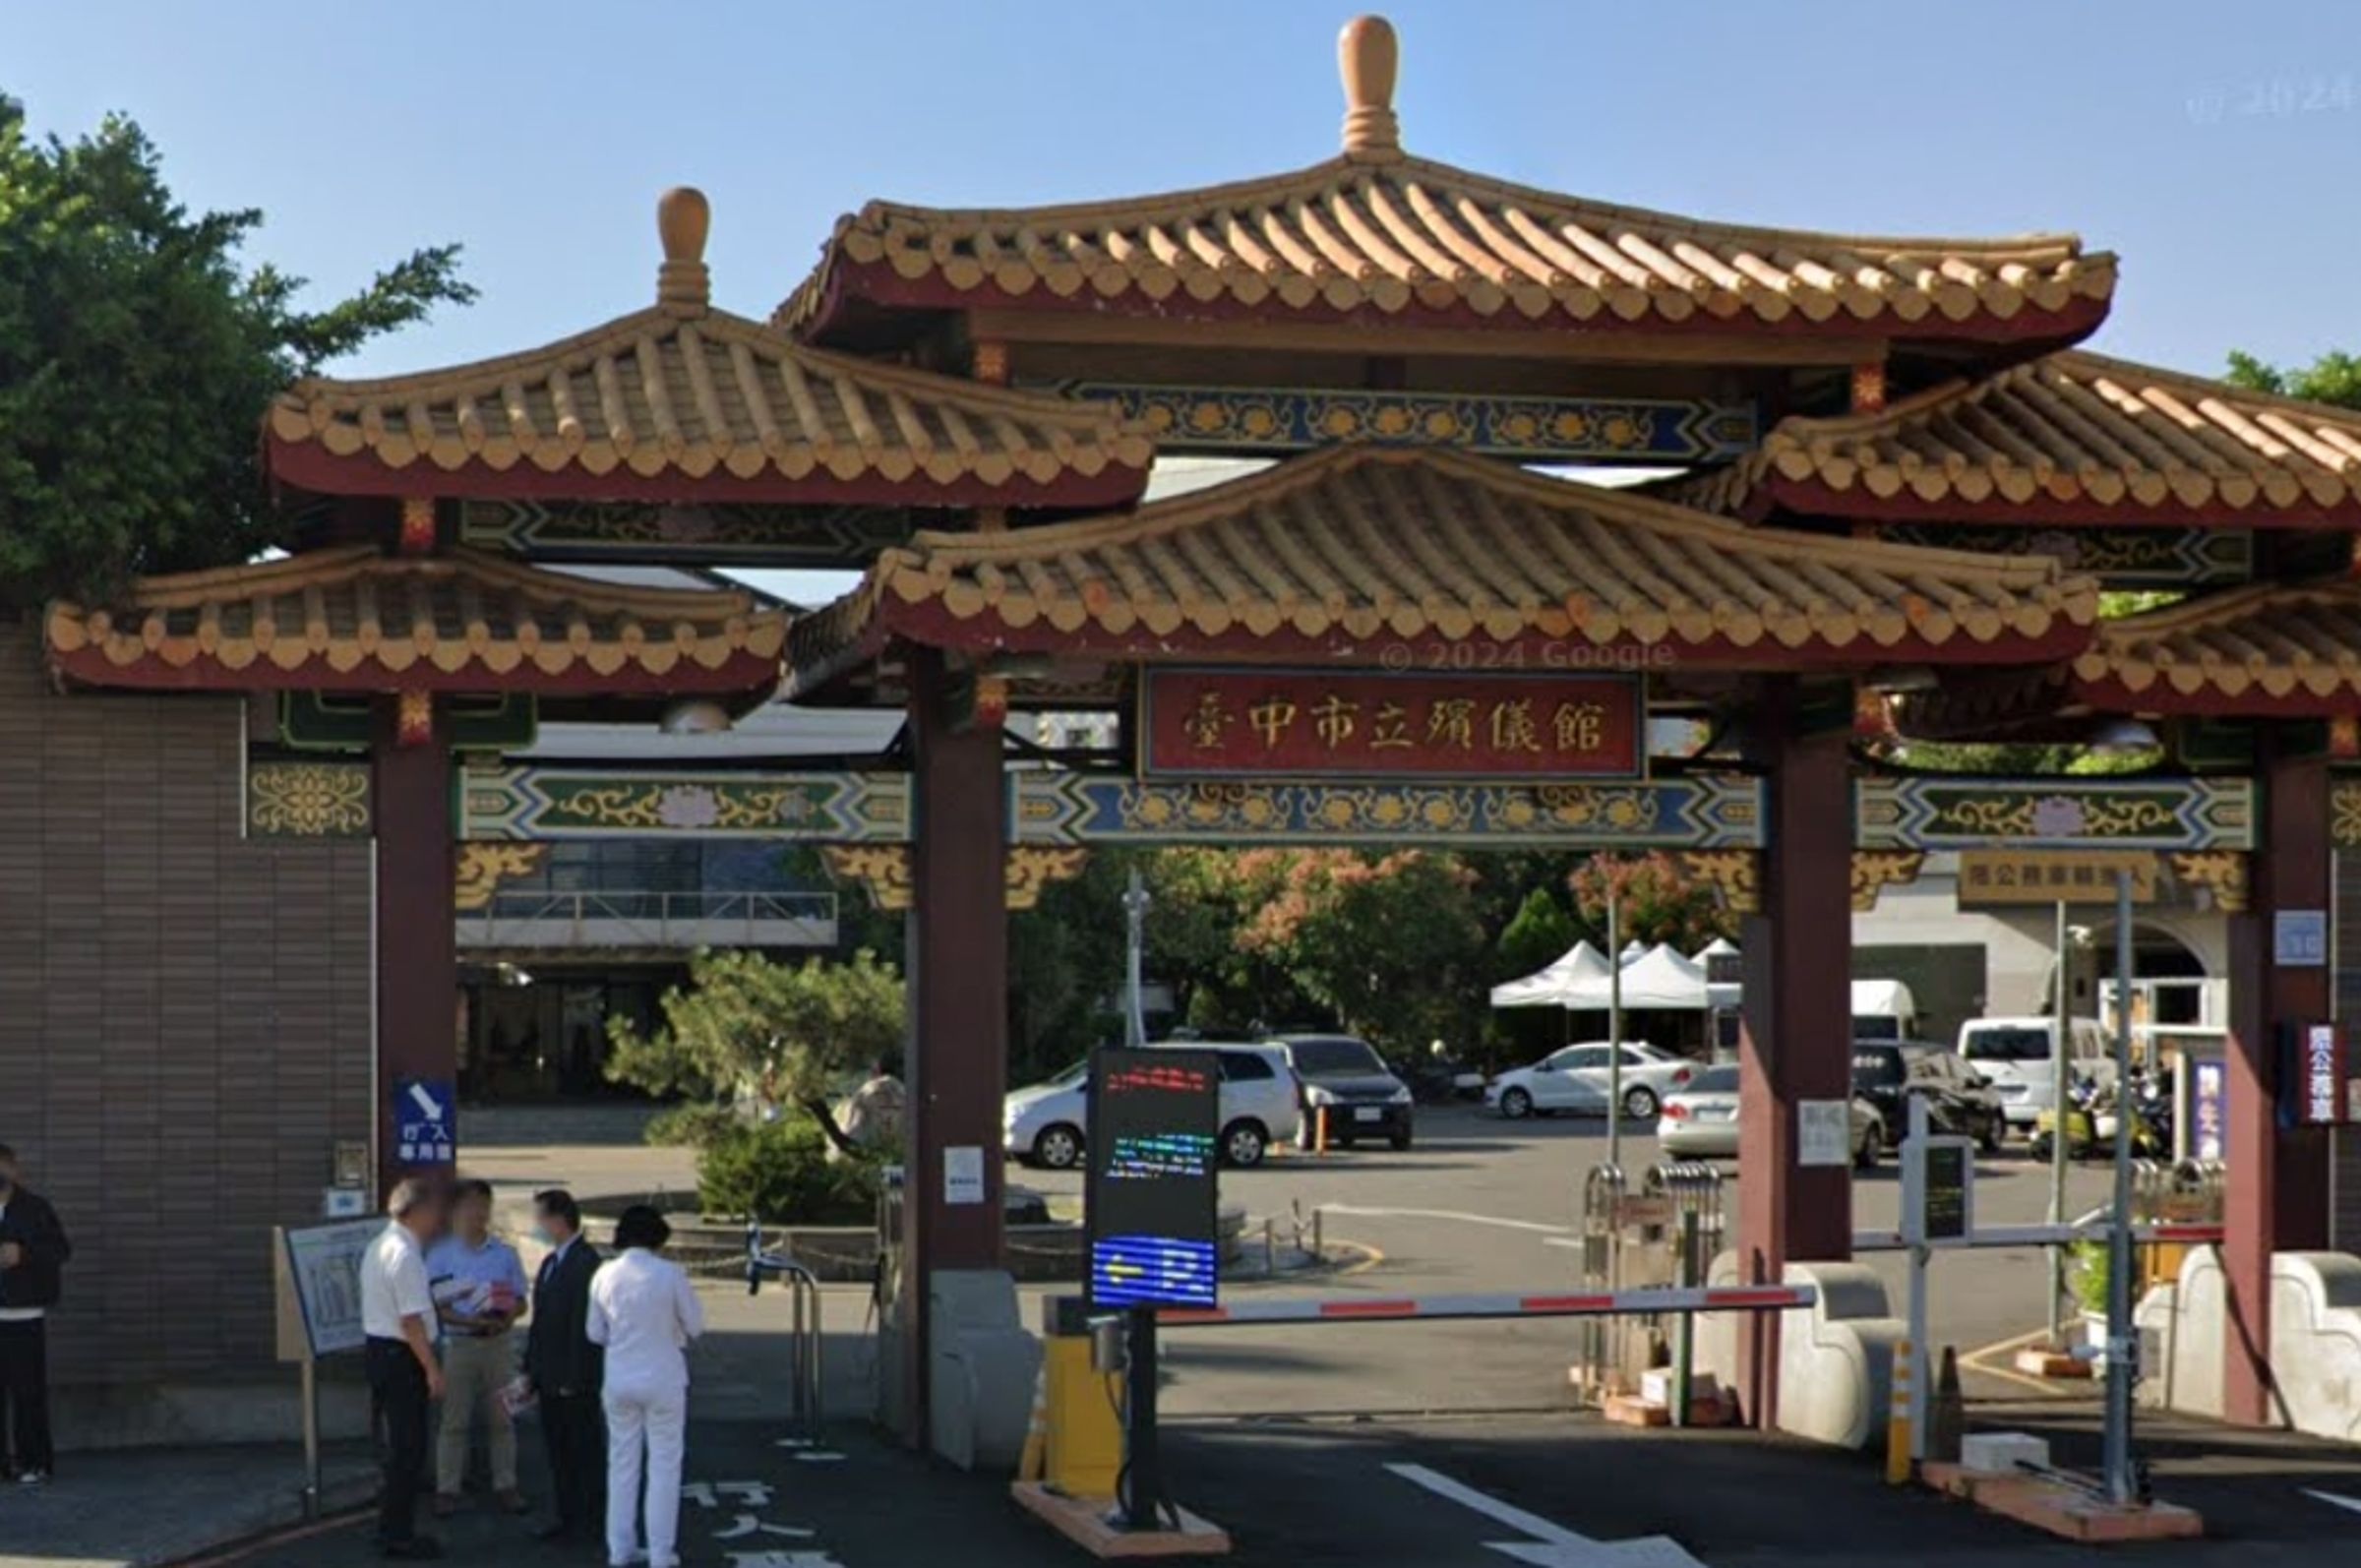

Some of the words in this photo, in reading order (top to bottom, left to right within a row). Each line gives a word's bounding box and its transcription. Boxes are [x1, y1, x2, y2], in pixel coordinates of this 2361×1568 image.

[1184, 693, 1605, 752] 臺中市立殯儀館
